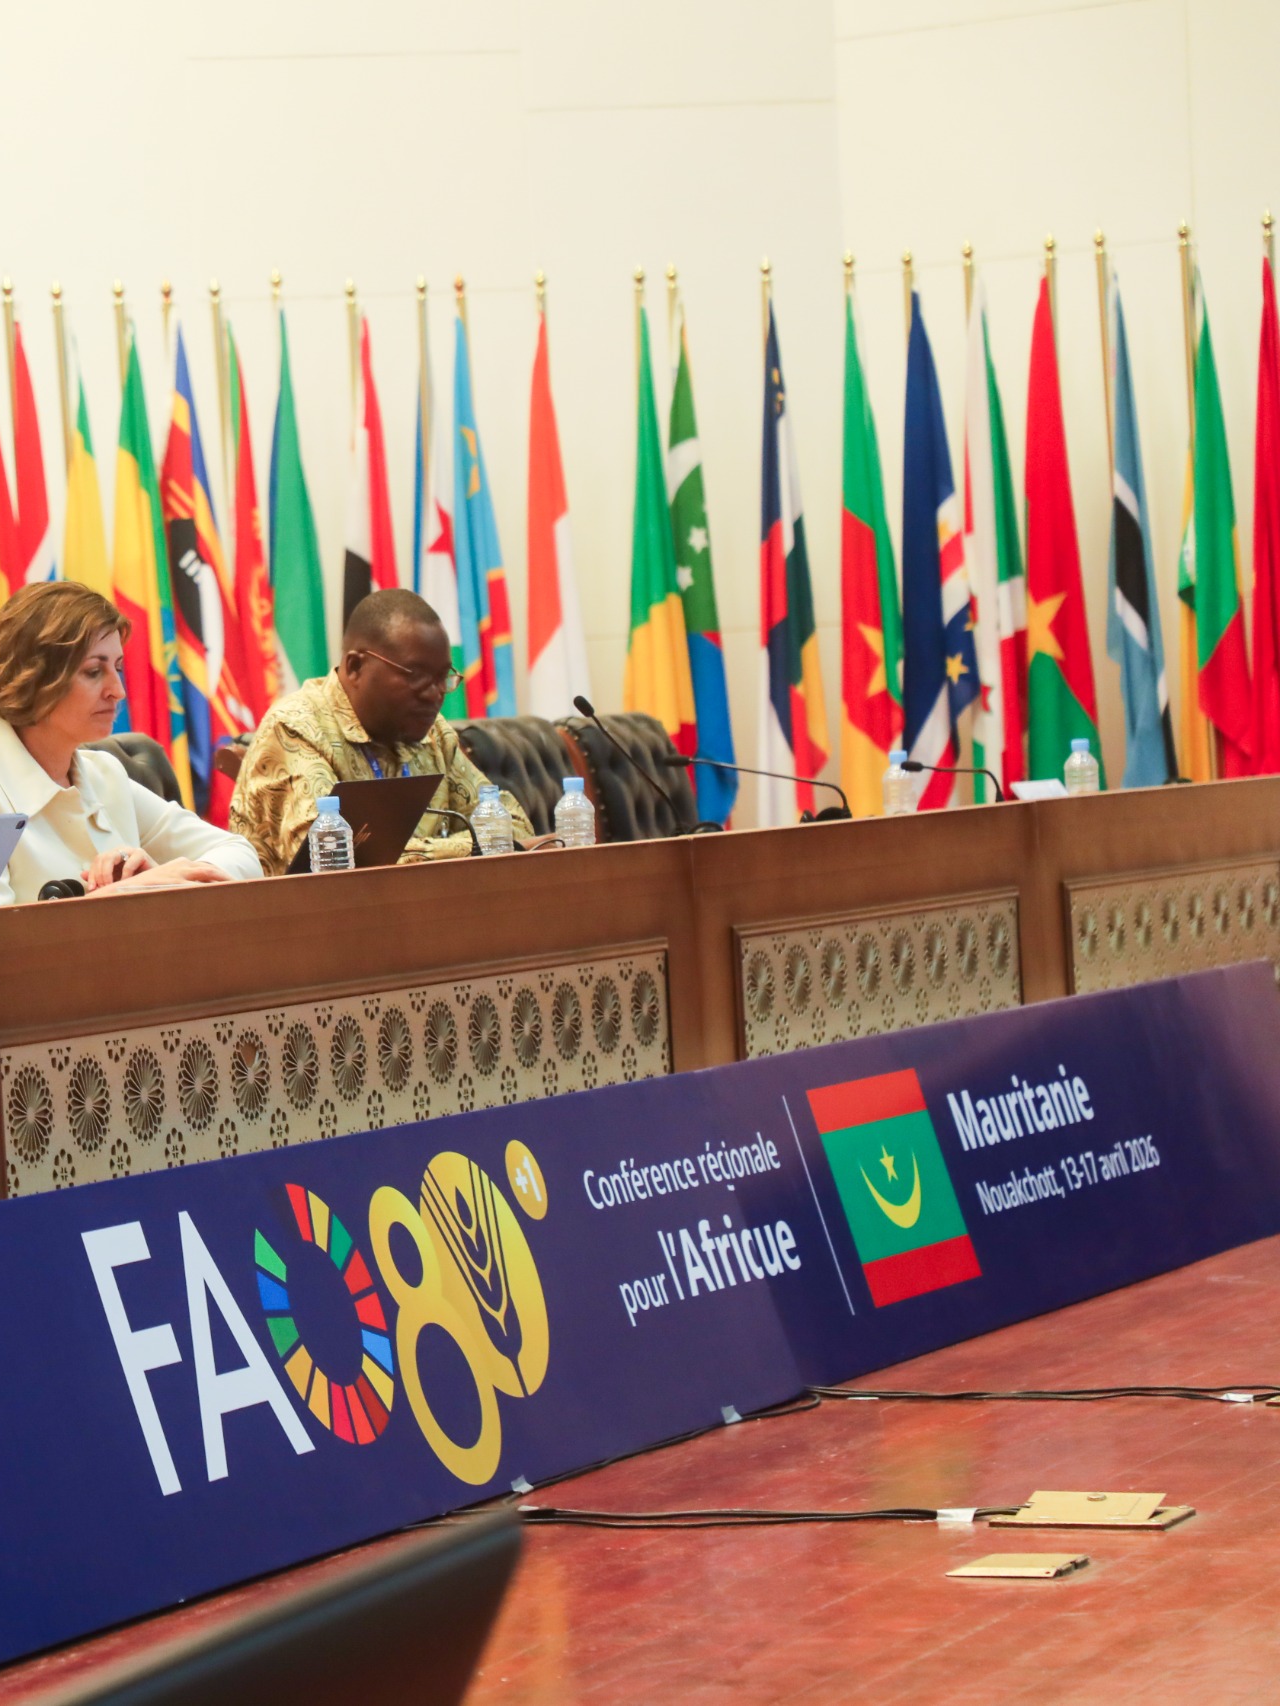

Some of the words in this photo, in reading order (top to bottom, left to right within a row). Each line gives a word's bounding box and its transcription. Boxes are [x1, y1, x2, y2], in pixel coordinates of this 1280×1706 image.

[946, 1063, 1095, 1152] Mauritanie
[583, 1157, 699, 1210] Conférence
[975, 1164, 1066, 1216] Nouakchott,
[1060, 1151, 1099, 1191] 13-17
[1098, 1141, 1131, 1181] avril
[1124, 1134, 1161, 1173] 2026
[81, 1183, 395, 1496] FAO
[619, 1273, 670, 1328] pour
